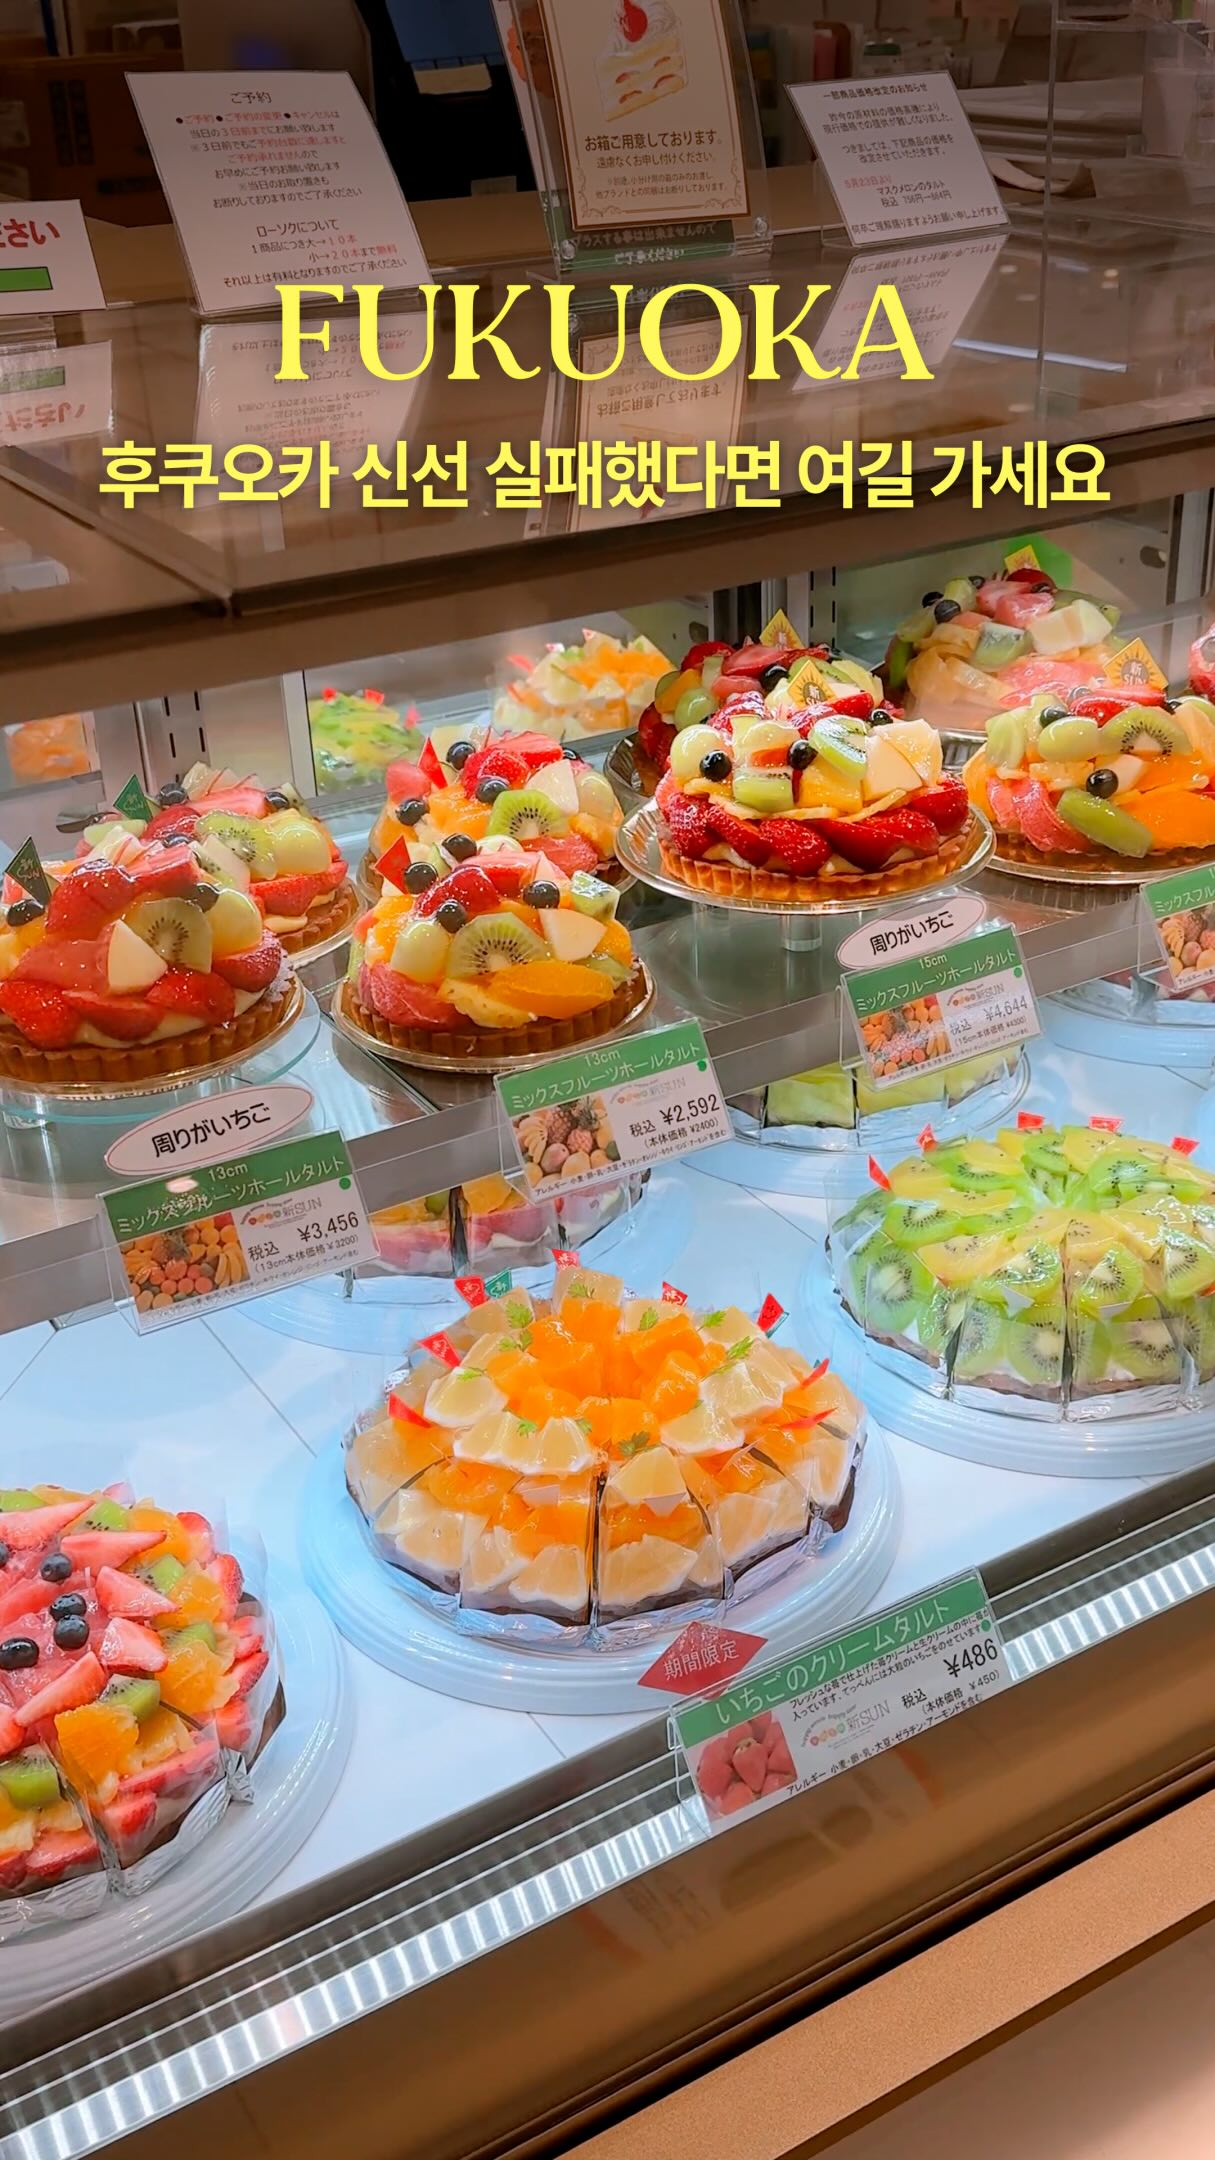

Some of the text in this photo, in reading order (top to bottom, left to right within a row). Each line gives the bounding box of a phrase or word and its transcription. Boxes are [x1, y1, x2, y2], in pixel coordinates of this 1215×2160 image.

[230, 91, 273, 105] ご予約
[585, 129, 722, 151] お箱ご用意しております。
[0, 218, 60, 248] さい
[256, 219, 341, 238] ローソクについて
[869, 910, 954, 955] 周りがいちご
[918, 953, 948, 970] 15cm
[856, 949, 1017, 1012] ミックスフルーツホールタルト
[983, 995, 1029, 1022] ¥4,644
[511, 1042, 701, 1109] ミックスフルーツホールタルト
[583, 1049, 621, 1068] 13cm
[151, 1102, 273, 1158] 周りがいちご
[629, 1119, 657, 1138] 税込
[659, 1094, 720, 1126] ¥2,592
[644, 1127, 688, 1149] (本体価格
[207, 1162, 250, 1183] 13cm
[247, 1241, 281, 1262] 税込
[297, 1211, 360, 1244] ¥3,456
[662, 1638, 741, 1682] 期間限定
[715, 1597, 950, 1726] いちごのクリームタルト
[900, 1637, 1000, 1710] 税込 ¥486
[921, 1669, 1001, 1716] (本体価格 ¥450)
[847, 1699, 892, 1733] 新SUN
[785, 1770, 828, 1797] アレルギー
